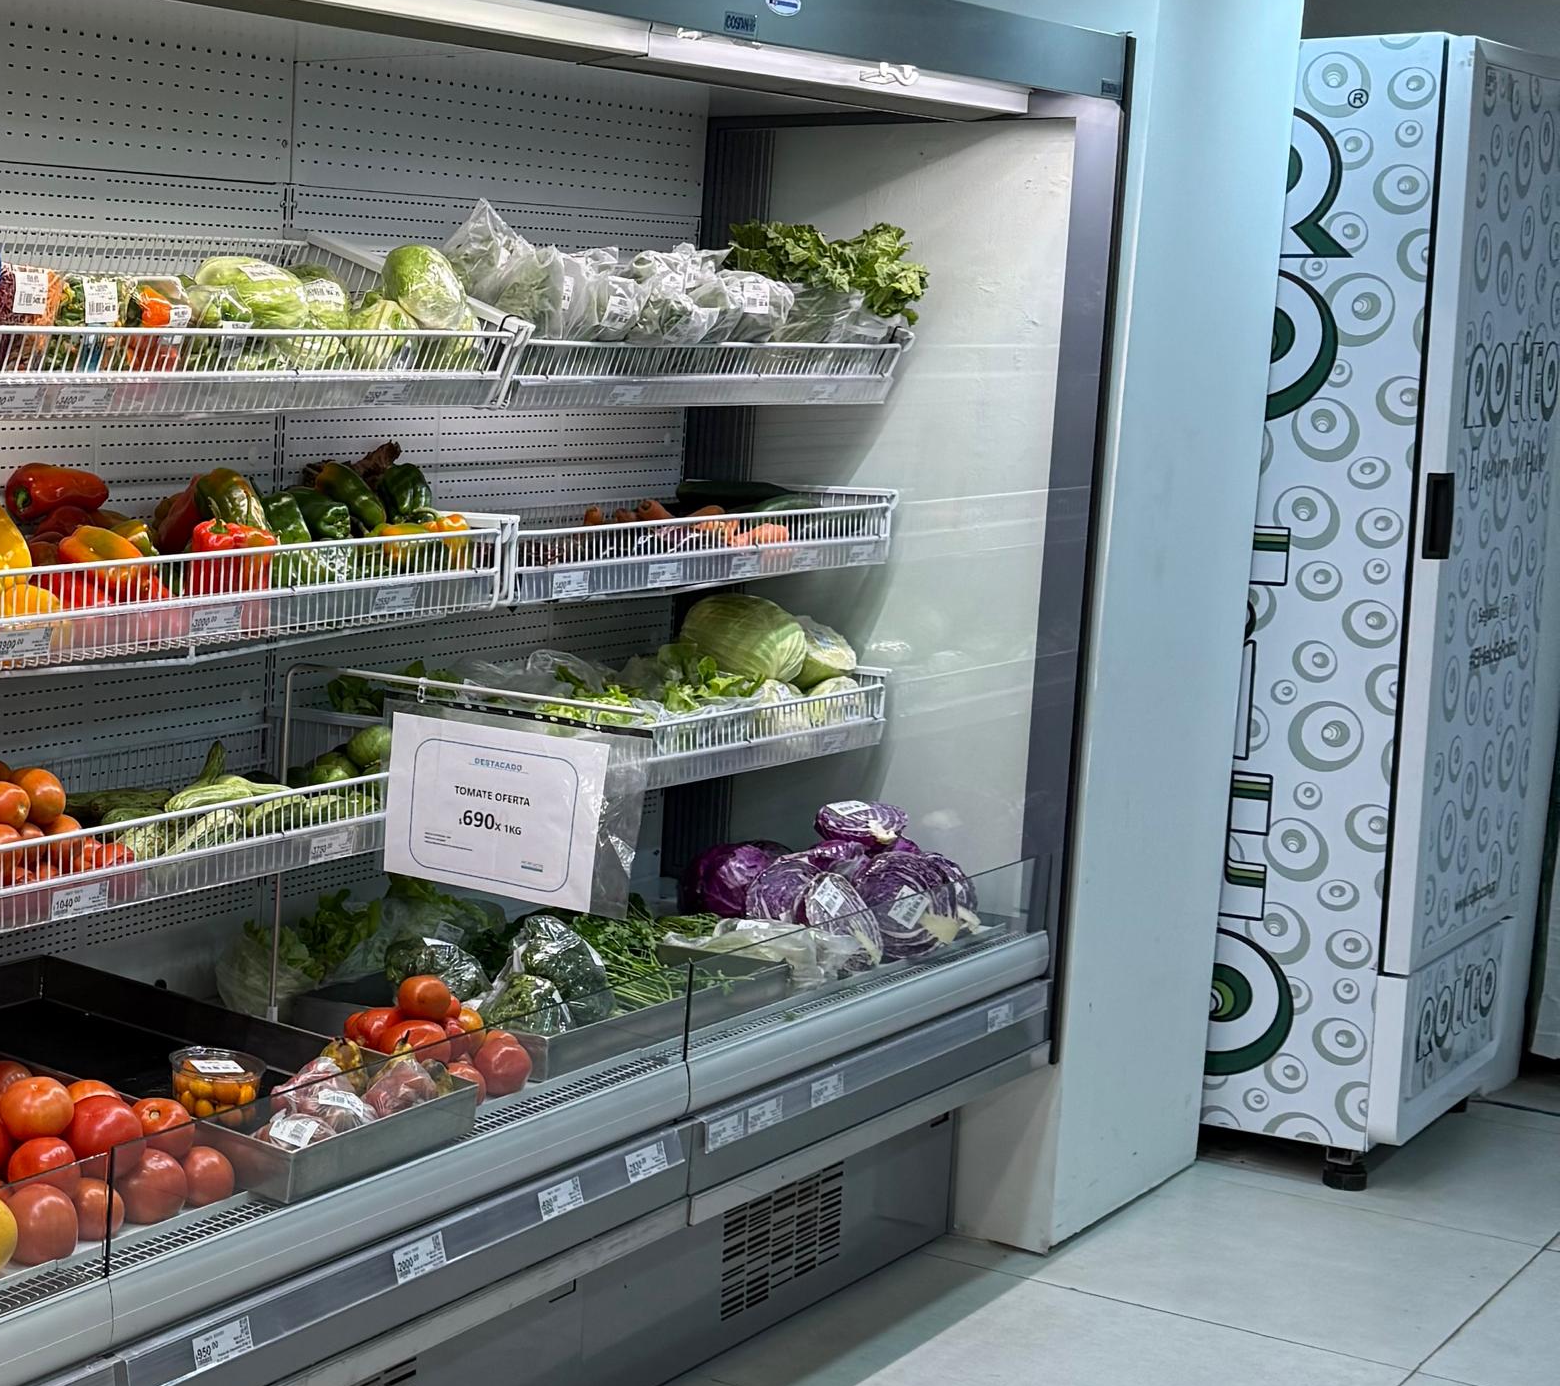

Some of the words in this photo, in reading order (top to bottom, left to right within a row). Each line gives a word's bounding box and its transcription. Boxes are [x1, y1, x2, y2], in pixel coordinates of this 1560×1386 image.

[474, 757, 523, 773] DESTACADO
[454, 785, 493, 802] TOMATE
[495, 792, 531, 807] OFERTA
[504, 824, 522, 836] 1KG
